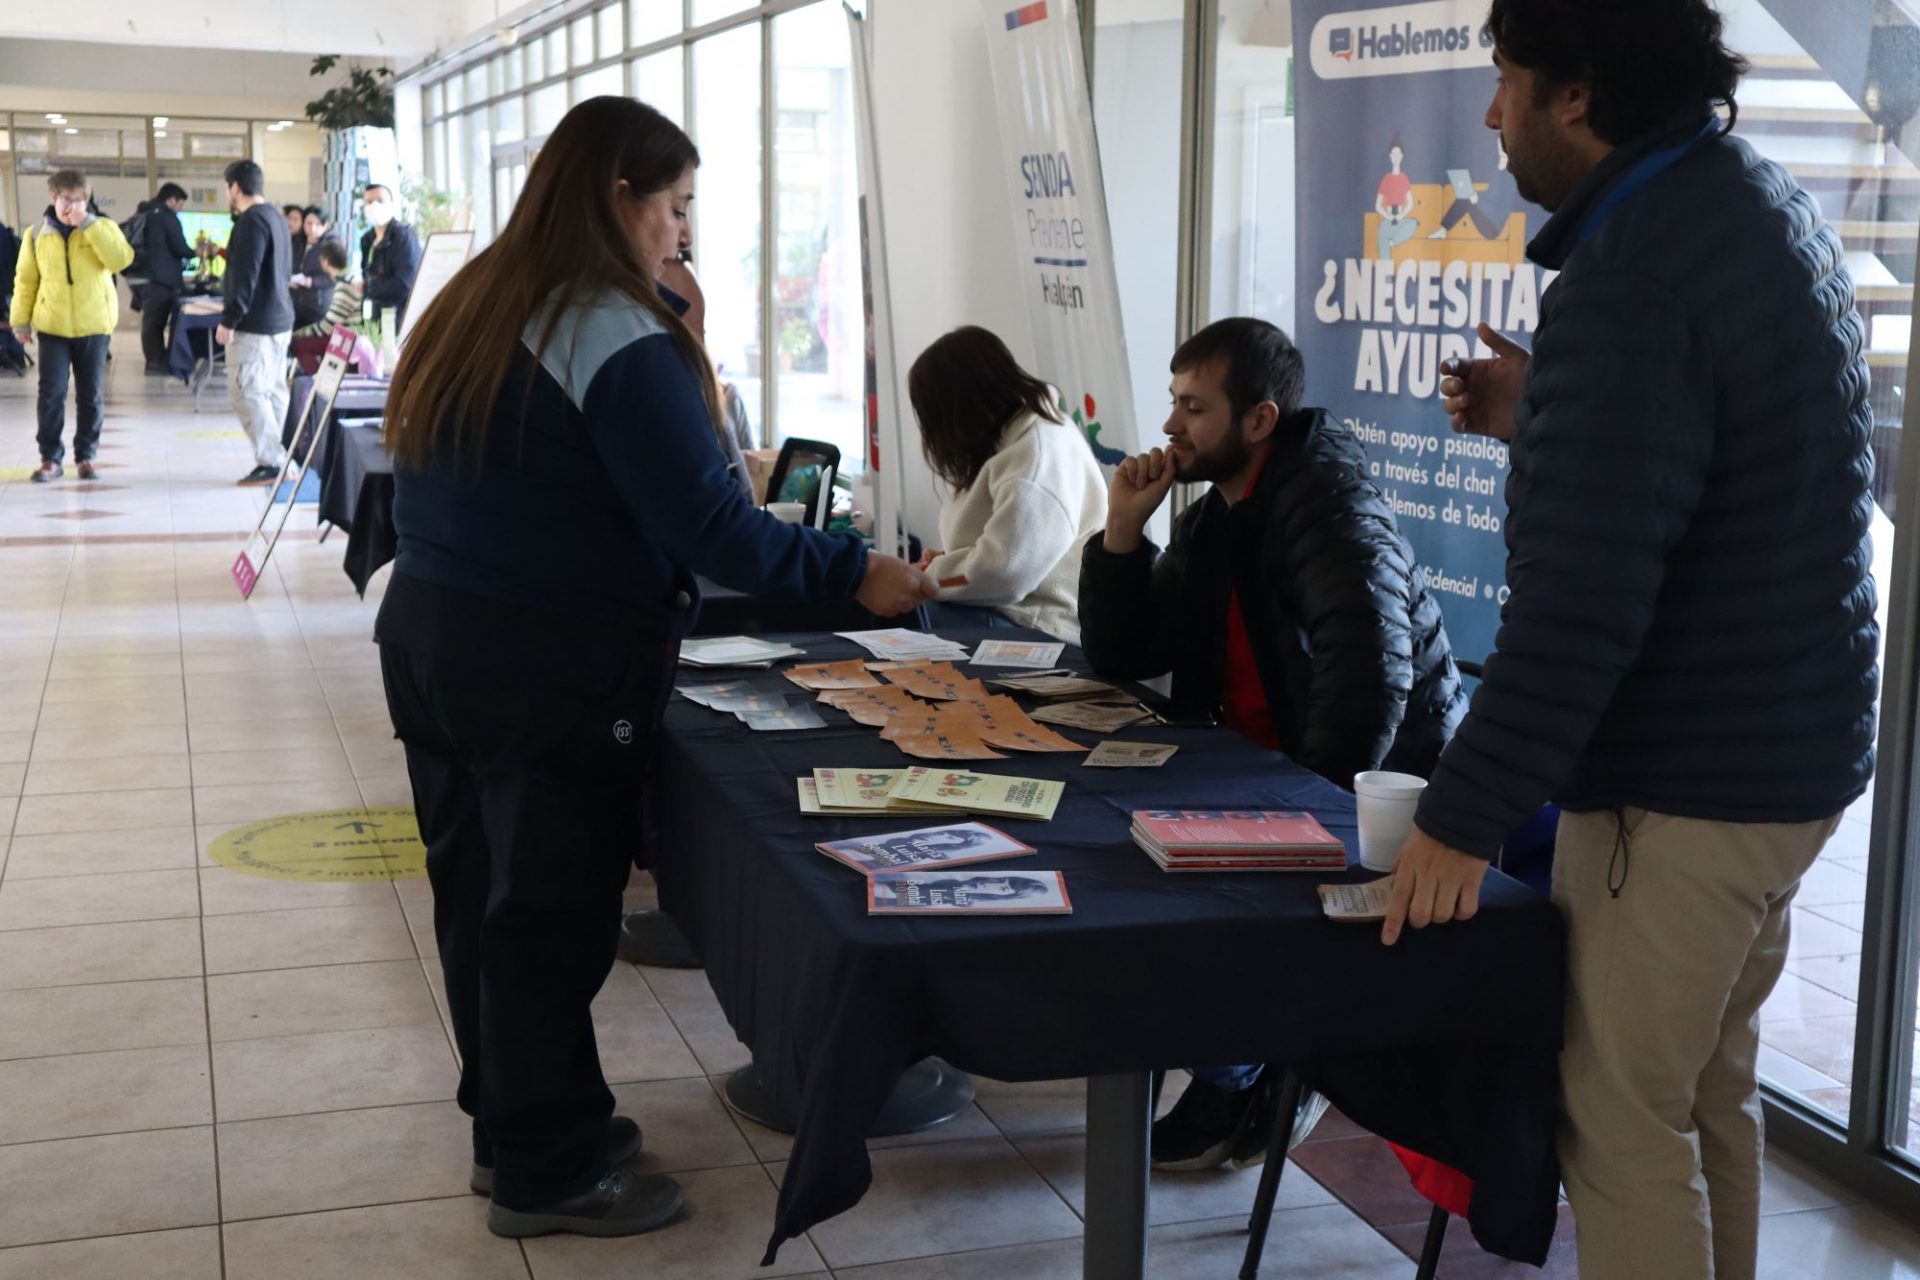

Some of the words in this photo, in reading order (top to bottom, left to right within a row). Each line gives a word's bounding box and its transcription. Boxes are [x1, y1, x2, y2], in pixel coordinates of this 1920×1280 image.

[1358, 21, 1470, 60] Hablemos
[1021, 151, 1076, 199] SENDA
[1315, 258, 1560, 334] ¿NECESITA
[1391, 431, 1439, 457] apoyo
[1444, 433, 1510, 469] psicológ
[1370, 461, 1380, 477] a
[1385, 459, 1429, 485] través
[1434, 462, 1460, 490] del
[1464, 467, 1496, 496] chat
[1384, 487, 1436, 520] blemos
[1442, 498, 1462, 525] de
[1466, 504, 1500, 533] Todo
[1424, 566, 1478, 599] fidencial
